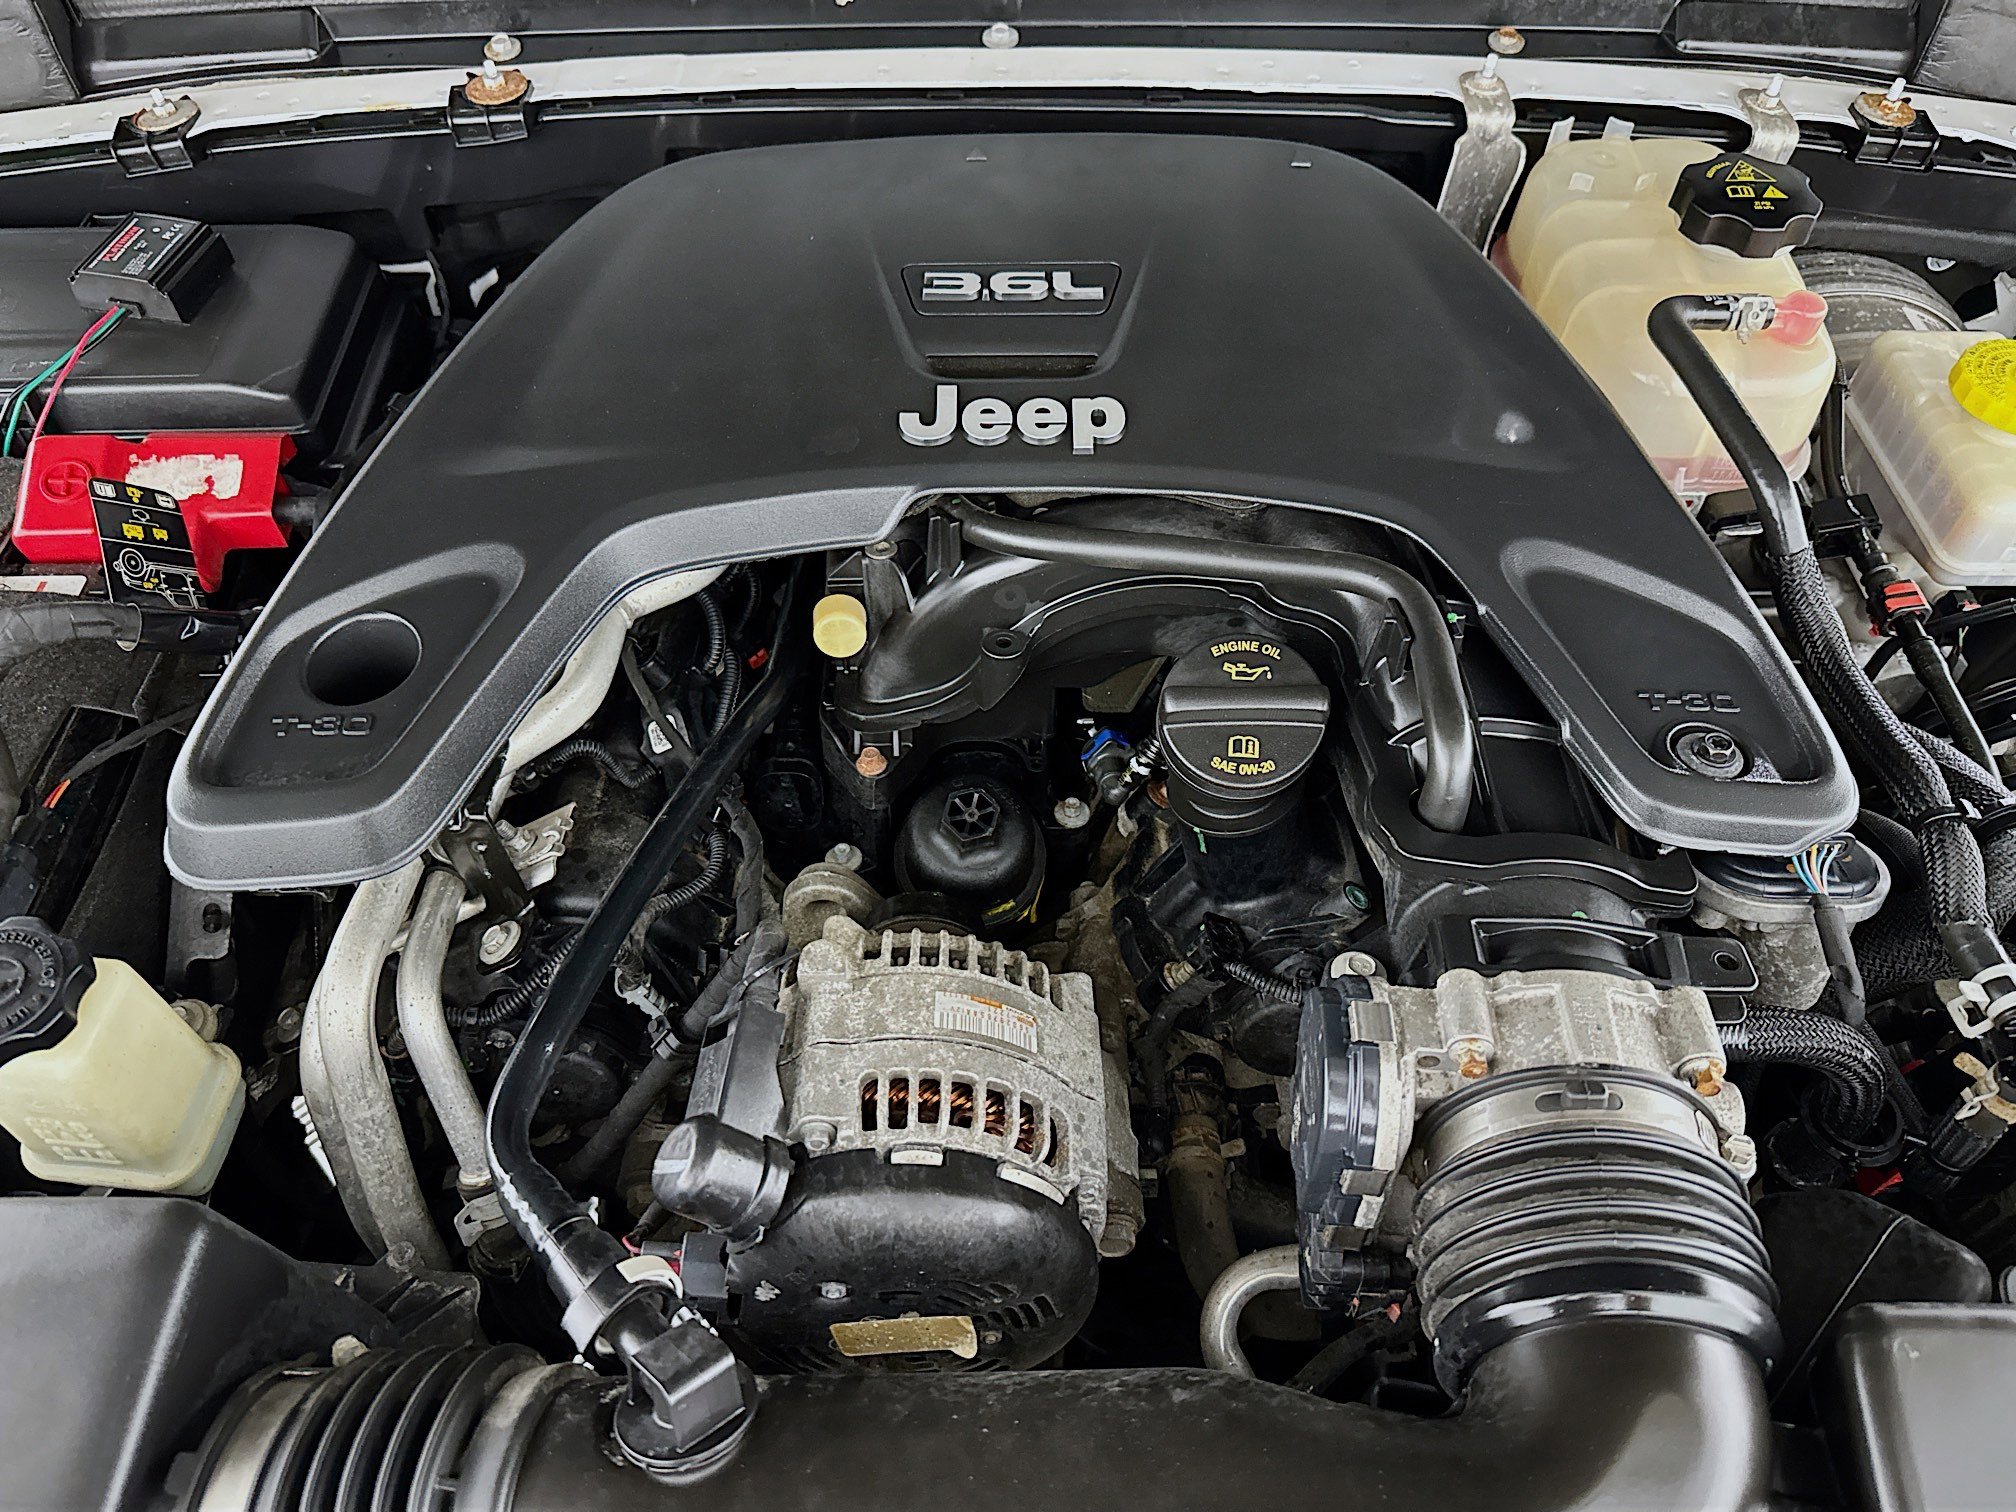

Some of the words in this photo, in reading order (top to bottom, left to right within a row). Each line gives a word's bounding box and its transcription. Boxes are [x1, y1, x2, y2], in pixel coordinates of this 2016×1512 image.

[102, 225, 141, 261] PLATINUM
[922, 271, 1104, 301] 3.6L
[899, 384, 1126, 455] Jeep
[1210, 640, 1260, 657] ENGINE
[1261, 644, 1281, 660] OIL
[1636, 691, 1741, 712] T-30
[271, 716, 372, 736] T-30
[1211, 756, 1237, 774] SAE
[1238, 760, 1275, 775] 0W-20
[35, 943, 57, 988] POWER
